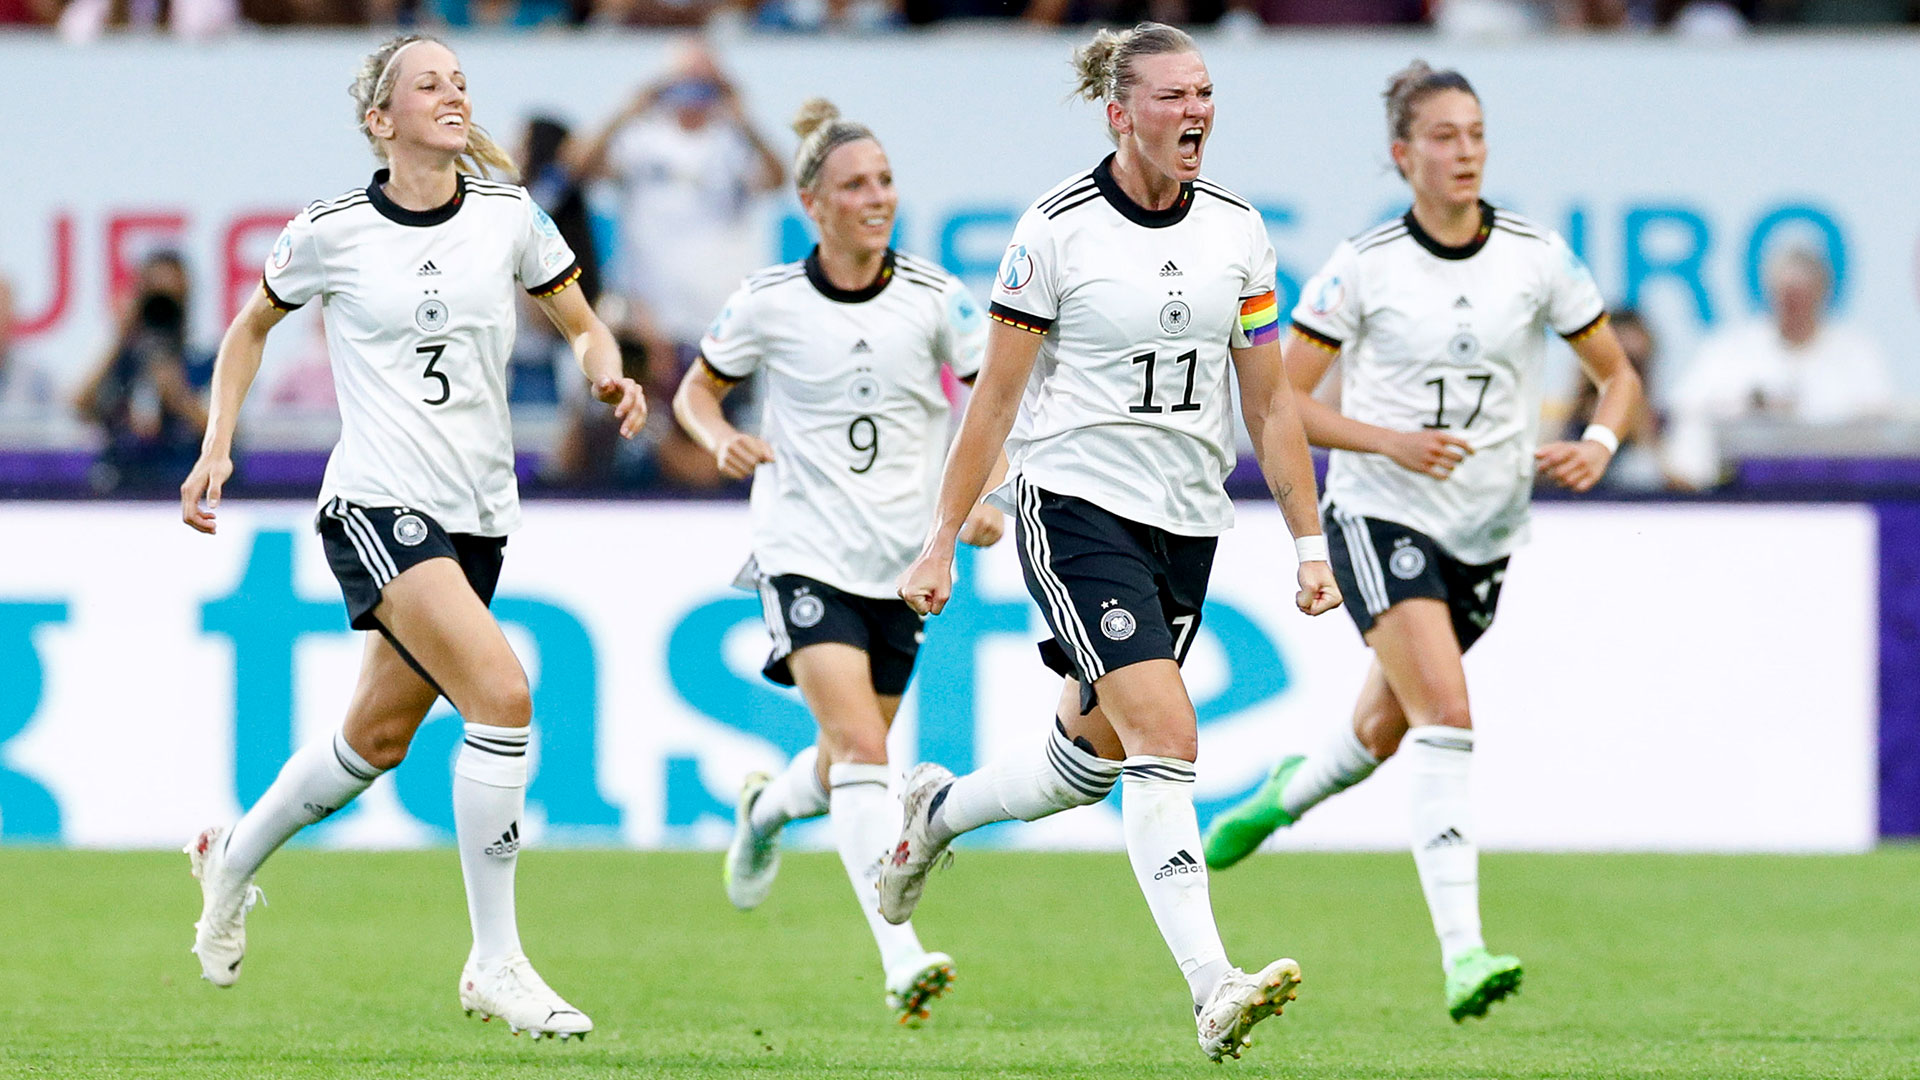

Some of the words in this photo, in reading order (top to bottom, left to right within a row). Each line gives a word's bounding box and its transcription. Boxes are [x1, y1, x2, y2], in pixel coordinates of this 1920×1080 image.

[415, 343, 451, 406] 3
[1129, 348, 1201, 414] 11
[1423, 374, 1492, 429] 17
[848, 415, 878, 474] 9
